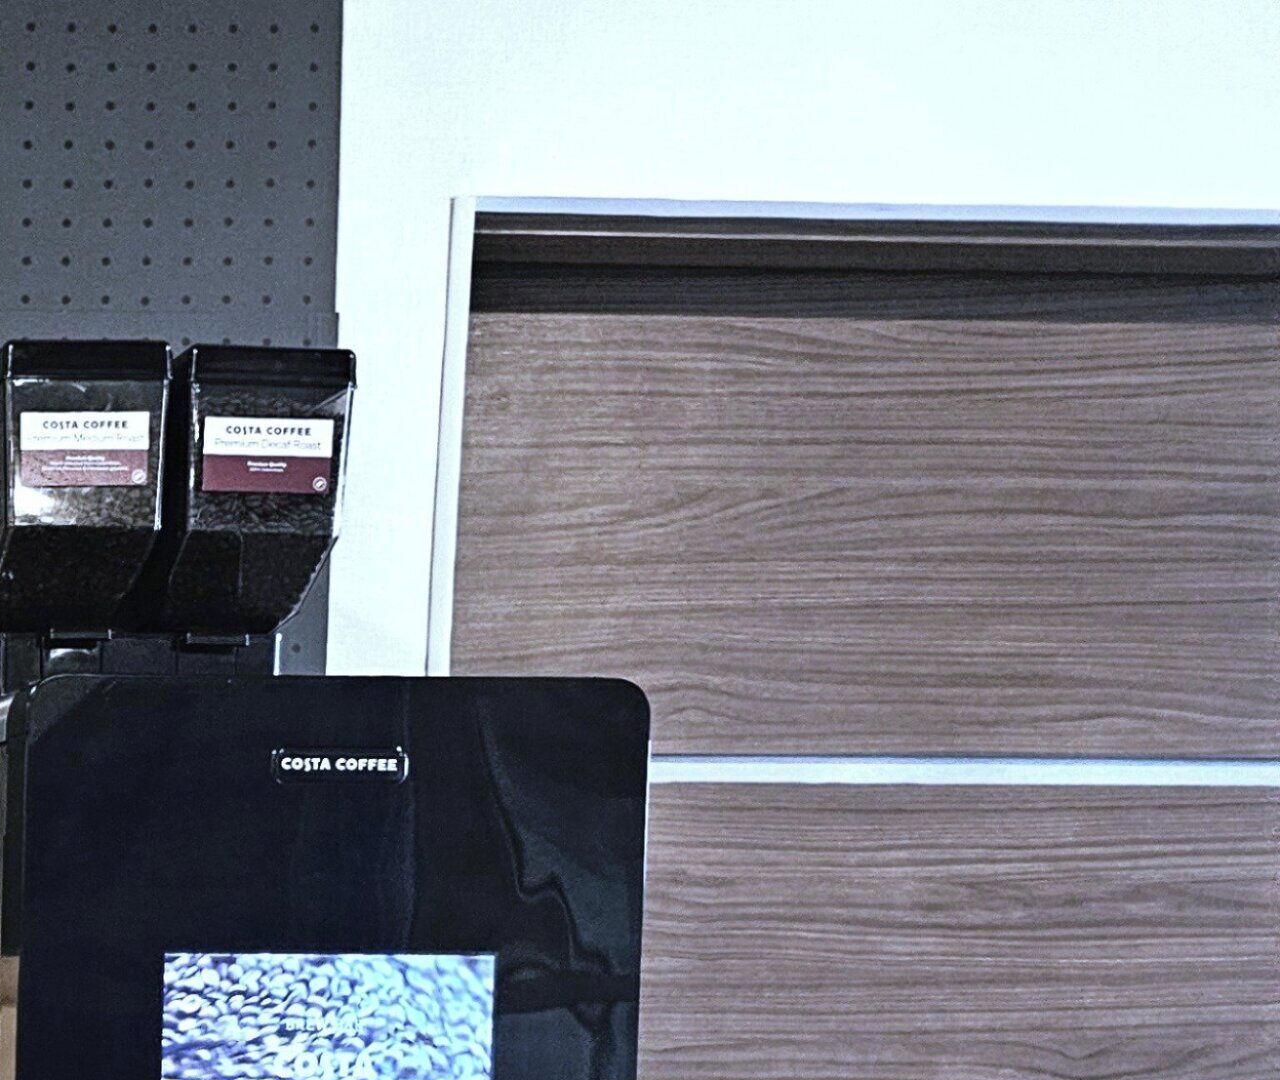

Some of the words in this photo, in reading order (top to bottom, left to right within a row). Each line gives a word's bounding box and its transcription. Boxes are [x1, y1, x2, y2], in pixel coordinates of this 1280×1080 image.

[43, 420, 78, 429] COSTA
[83, 420, 128, 429] COFFEE
[226, 425, 262, 435] COSTA
[266, 427, 311, 436] COFFEE
[281, 757, 331, 772] COSTA
[335, 757, 398, 771] COFFEE
